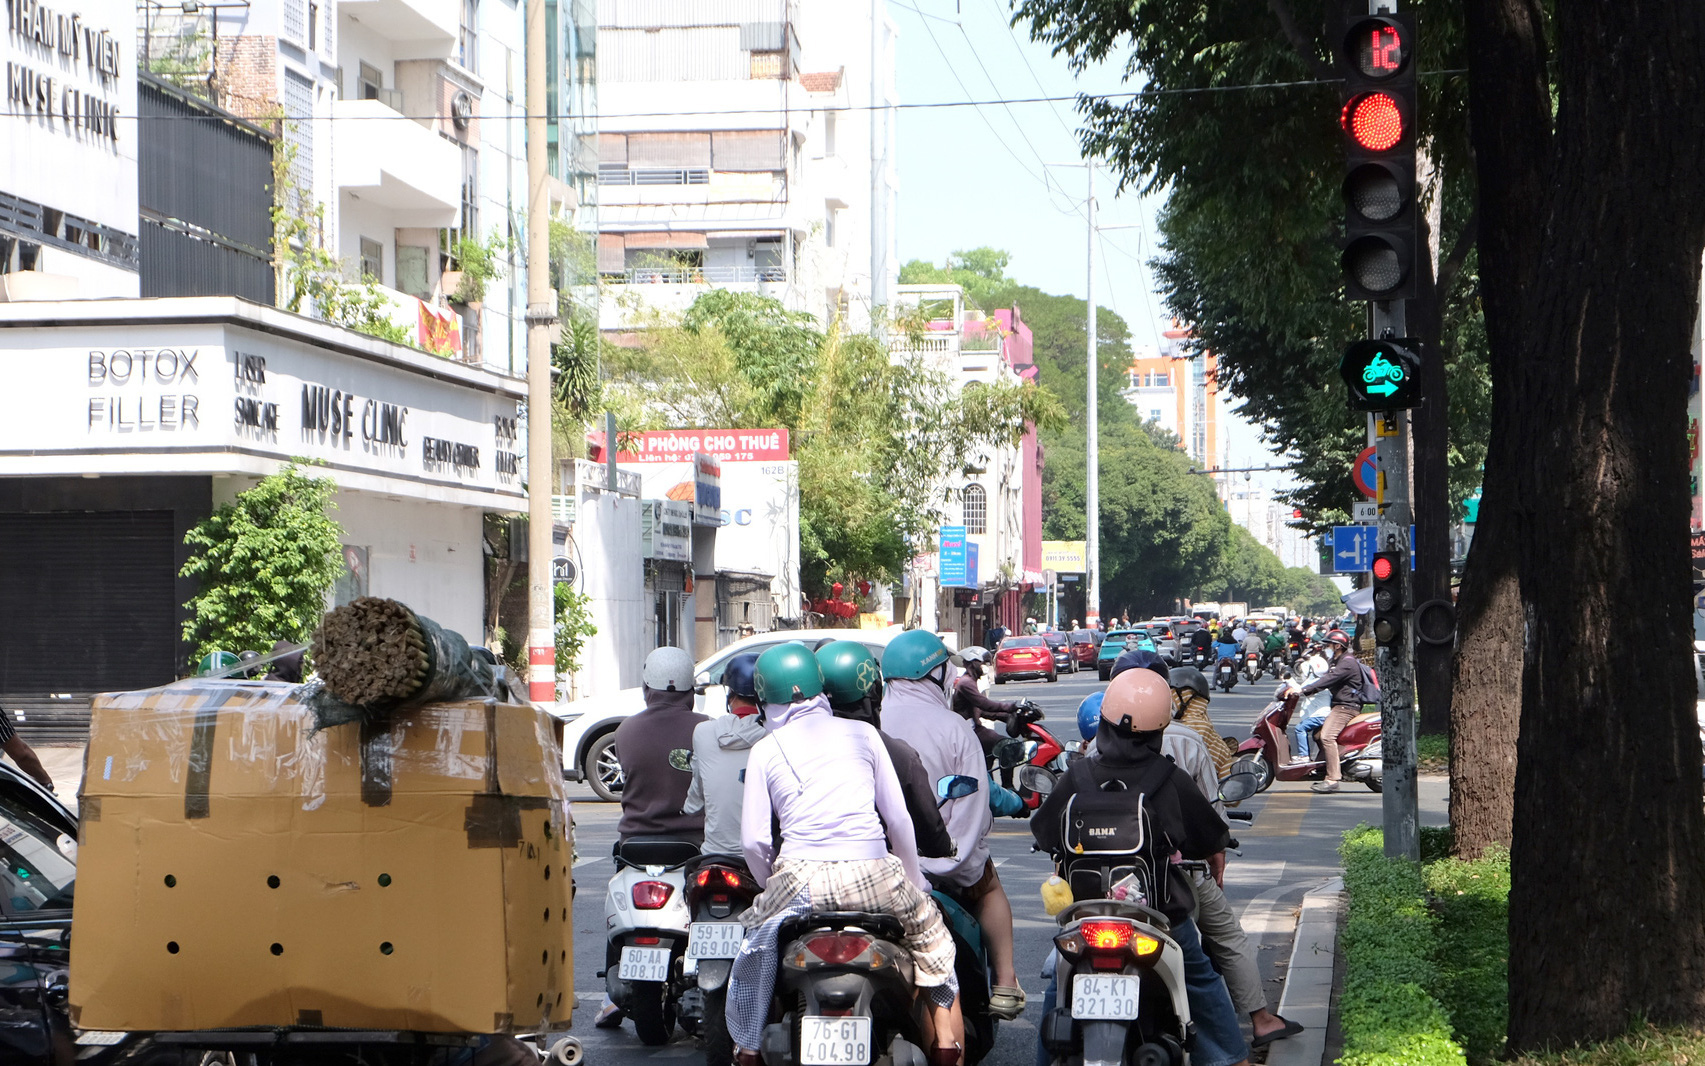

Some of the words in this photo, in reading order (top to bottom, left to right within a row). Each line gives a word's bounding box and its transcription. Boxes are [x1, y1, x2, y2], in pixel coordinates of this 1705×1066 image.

[1372, 26, 1400, 69] 12
[7, 61, 57, 116] MUSE
[62, 84, 120, 141] CLINIC
[89, 349, 199, 379] BOTOX
[89, 394, 199, 427] FILLER
[302, 383, 354, 438] MUSE
[362, 399, 408, 447] CLINIC
[648, 433, 700, 451] PHÒNG
[703, 435, 736, 450] CHO
[739, 432, 779, 450] THUÊ
[639, 452, 662, 462] Liên
[735, 452, 754, 460] 175
[761, 466, 785, 475] 162B
[920, 652, 938, 667] XANH
[1088, 827, 1116, 836] BAMA
[697, 925, 734, 940] 59-V1
[628, 949, 662, 964] 60-AA
[691, 941, 739, 956] 069.06
[621, 964, 666, 979] 308.10
[1083, 978, 1127, 996] 84-K1
[1076, 997, 1134, 1016] 321.30
[813, 1021, 858, 1040] 76-G1
[806, 1042, 866, 1061] 404.98
